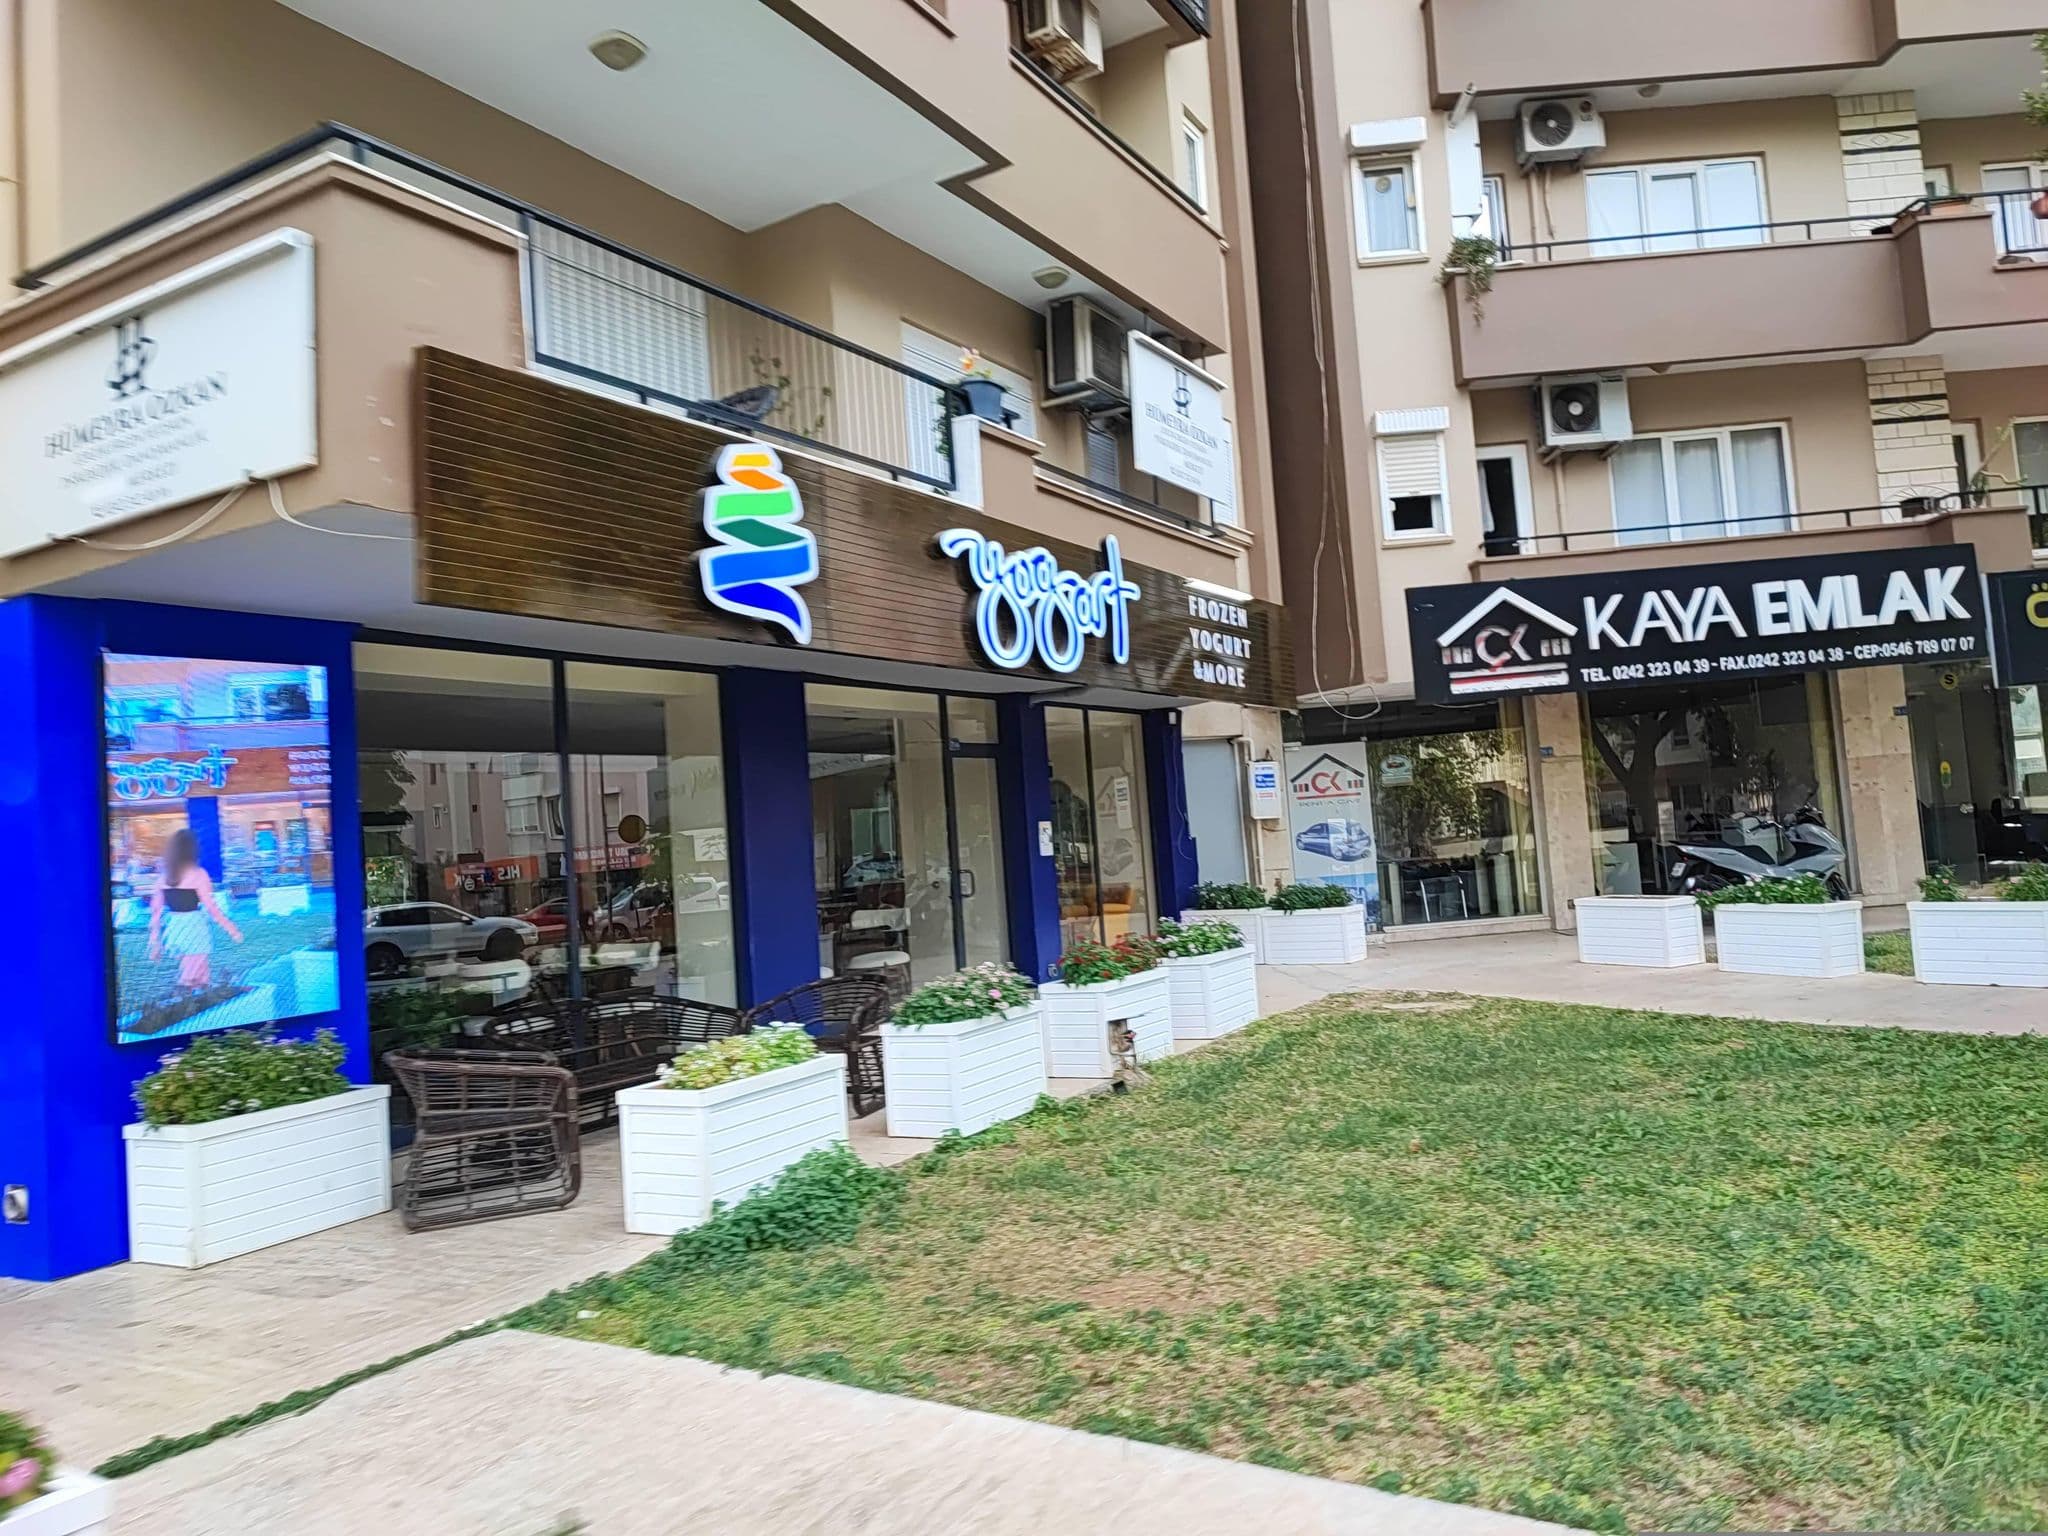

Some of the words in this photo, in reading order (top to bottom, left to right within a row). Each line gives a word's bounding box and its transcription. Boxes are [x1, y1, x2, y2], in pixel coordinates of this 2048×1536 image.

[1188, 594, 1249, 629] FROZEN
[1583, 585, 1749, 650] KAYA
[1751, 565, 1972, 636] EMLAK
[1188, 627, 1252, 659] YOGURT
[1580, 667, 1611, 683] TEL.
[1612, 664, 1646, 680] 0242
[1647, 661, 1672, 677] 323
[1673, 659, 1692, 675] 04
[1692, 658, 1710, 674] 39
[1782, 650, 1807, 666] 323
[1807, 649, 1825, 664] 04
[1827, 647, 1844, 662] 38
[1914, 639, 1939, 655] 789
[1940, 637, 1957, 653] 07
[1959, 636, 1976, 651] 07
[1193, 658, 1247, 688] &MORE
